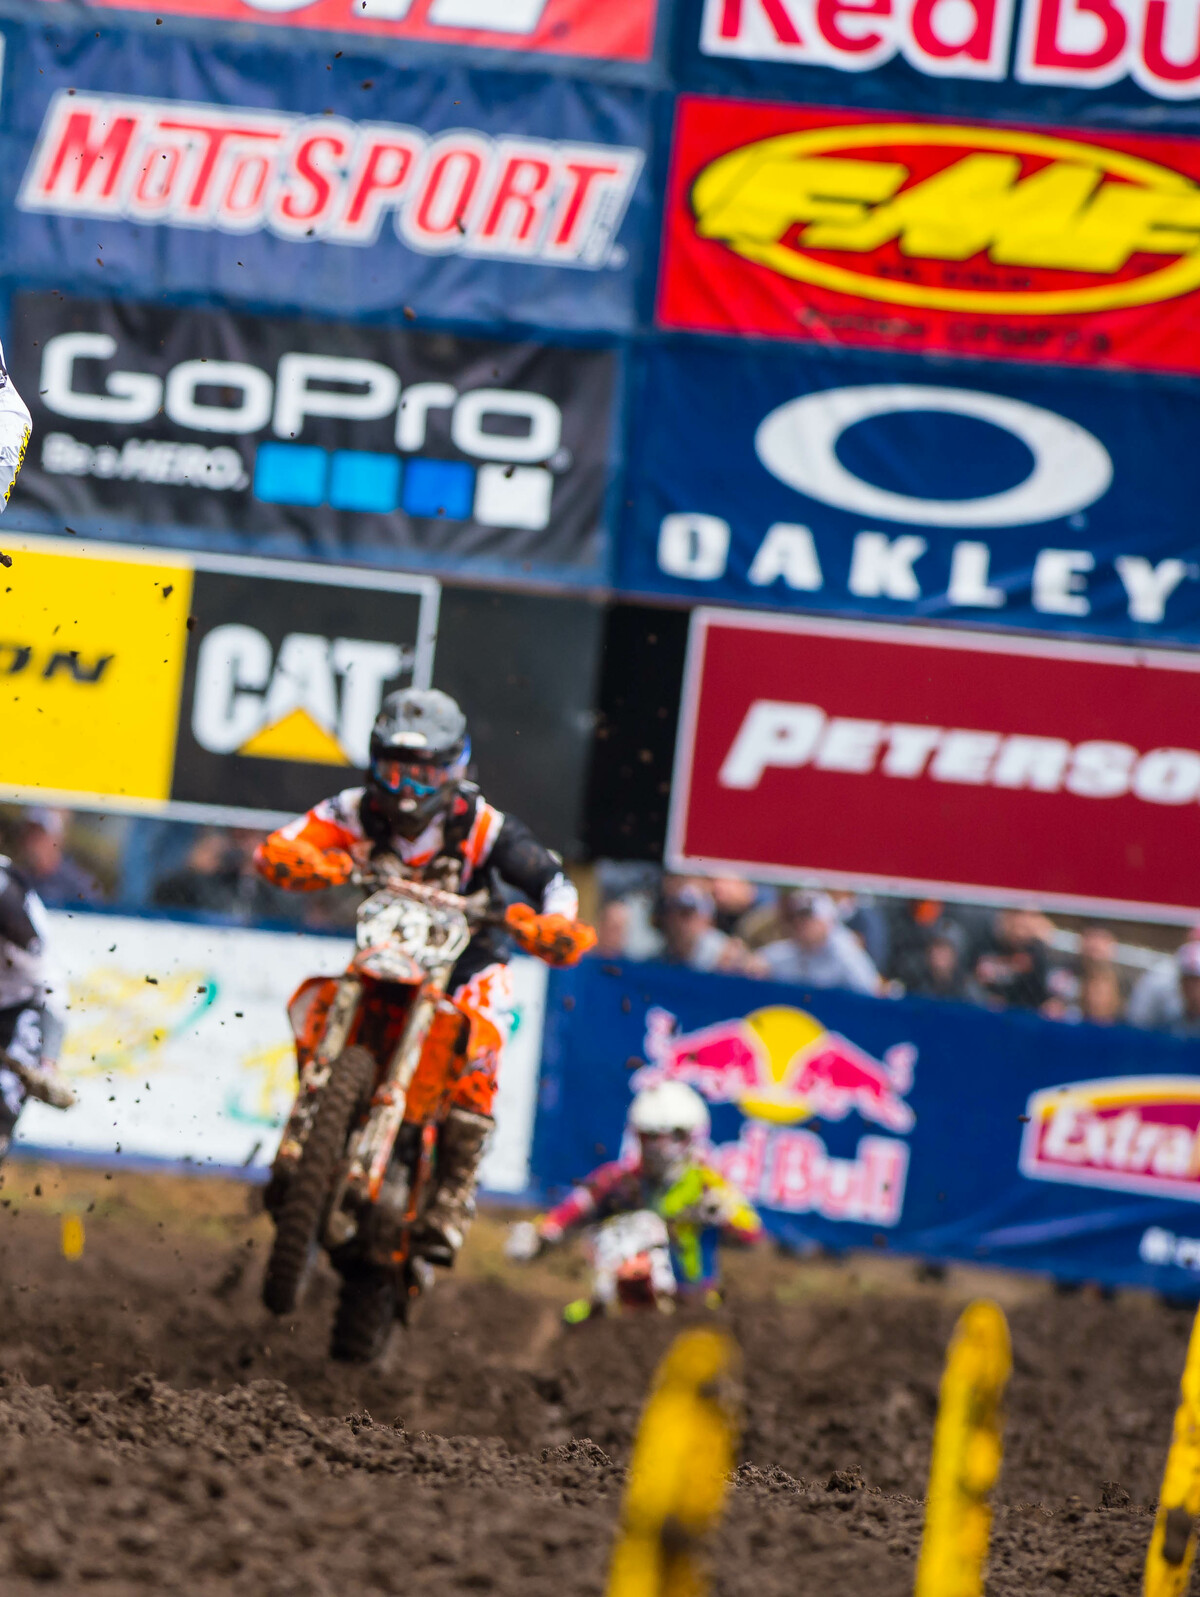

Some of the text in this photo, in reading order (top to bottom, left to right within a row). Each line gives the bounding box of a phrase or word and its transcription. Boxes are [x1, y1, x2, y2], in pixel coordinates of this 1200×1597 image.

[692, 150, 1200, 274] FMF
[40, 332, 562, 463] GoPro
[656, 511, 1185, 624] OAKLEY
[191, 623, 402, 769] CAT
[717, 699, 1200, 806] PETERSO
[1043, 1104, 1193, 1178] Extra
